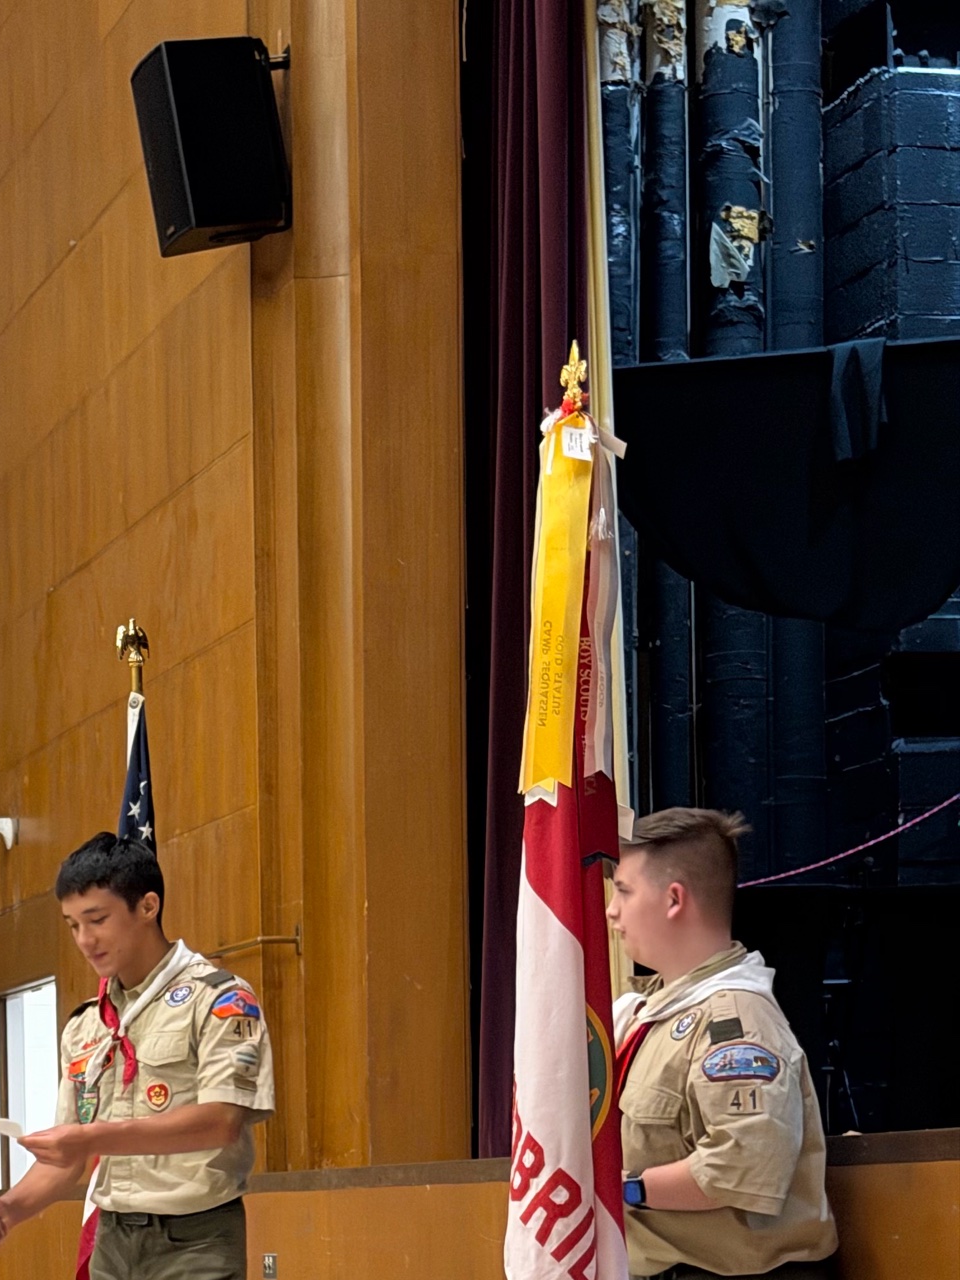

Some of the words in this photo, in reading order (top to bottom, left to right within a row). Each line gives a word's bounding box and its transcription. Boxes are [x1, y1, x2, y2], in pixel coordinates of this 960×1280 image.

[580, 637, 592, 666] BOY
[233, 1020, 252, 1038] 41
[730, 1088, 757, 1111] 41
